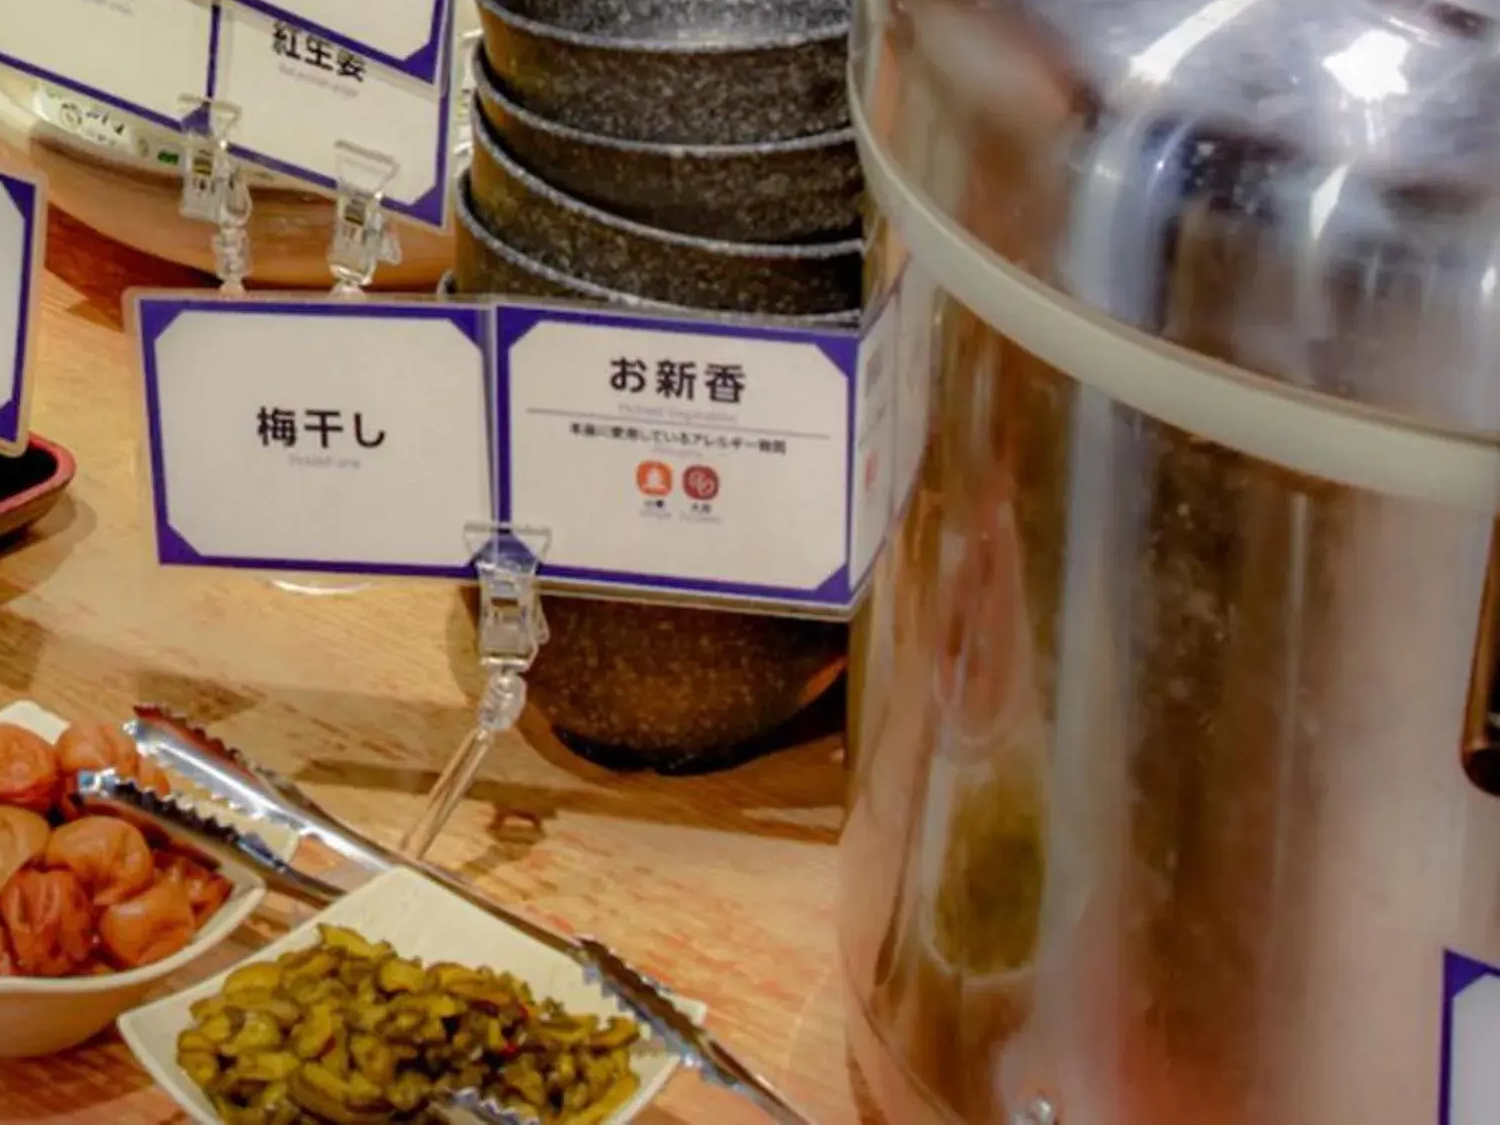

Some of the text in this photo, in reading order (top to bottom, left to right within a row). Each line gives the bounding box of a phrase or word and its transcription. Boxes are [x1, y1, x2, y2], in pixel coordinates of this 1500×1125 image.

[608, 355, 746, 405] お新香
[256, 406, 386, 449] 梅干し
